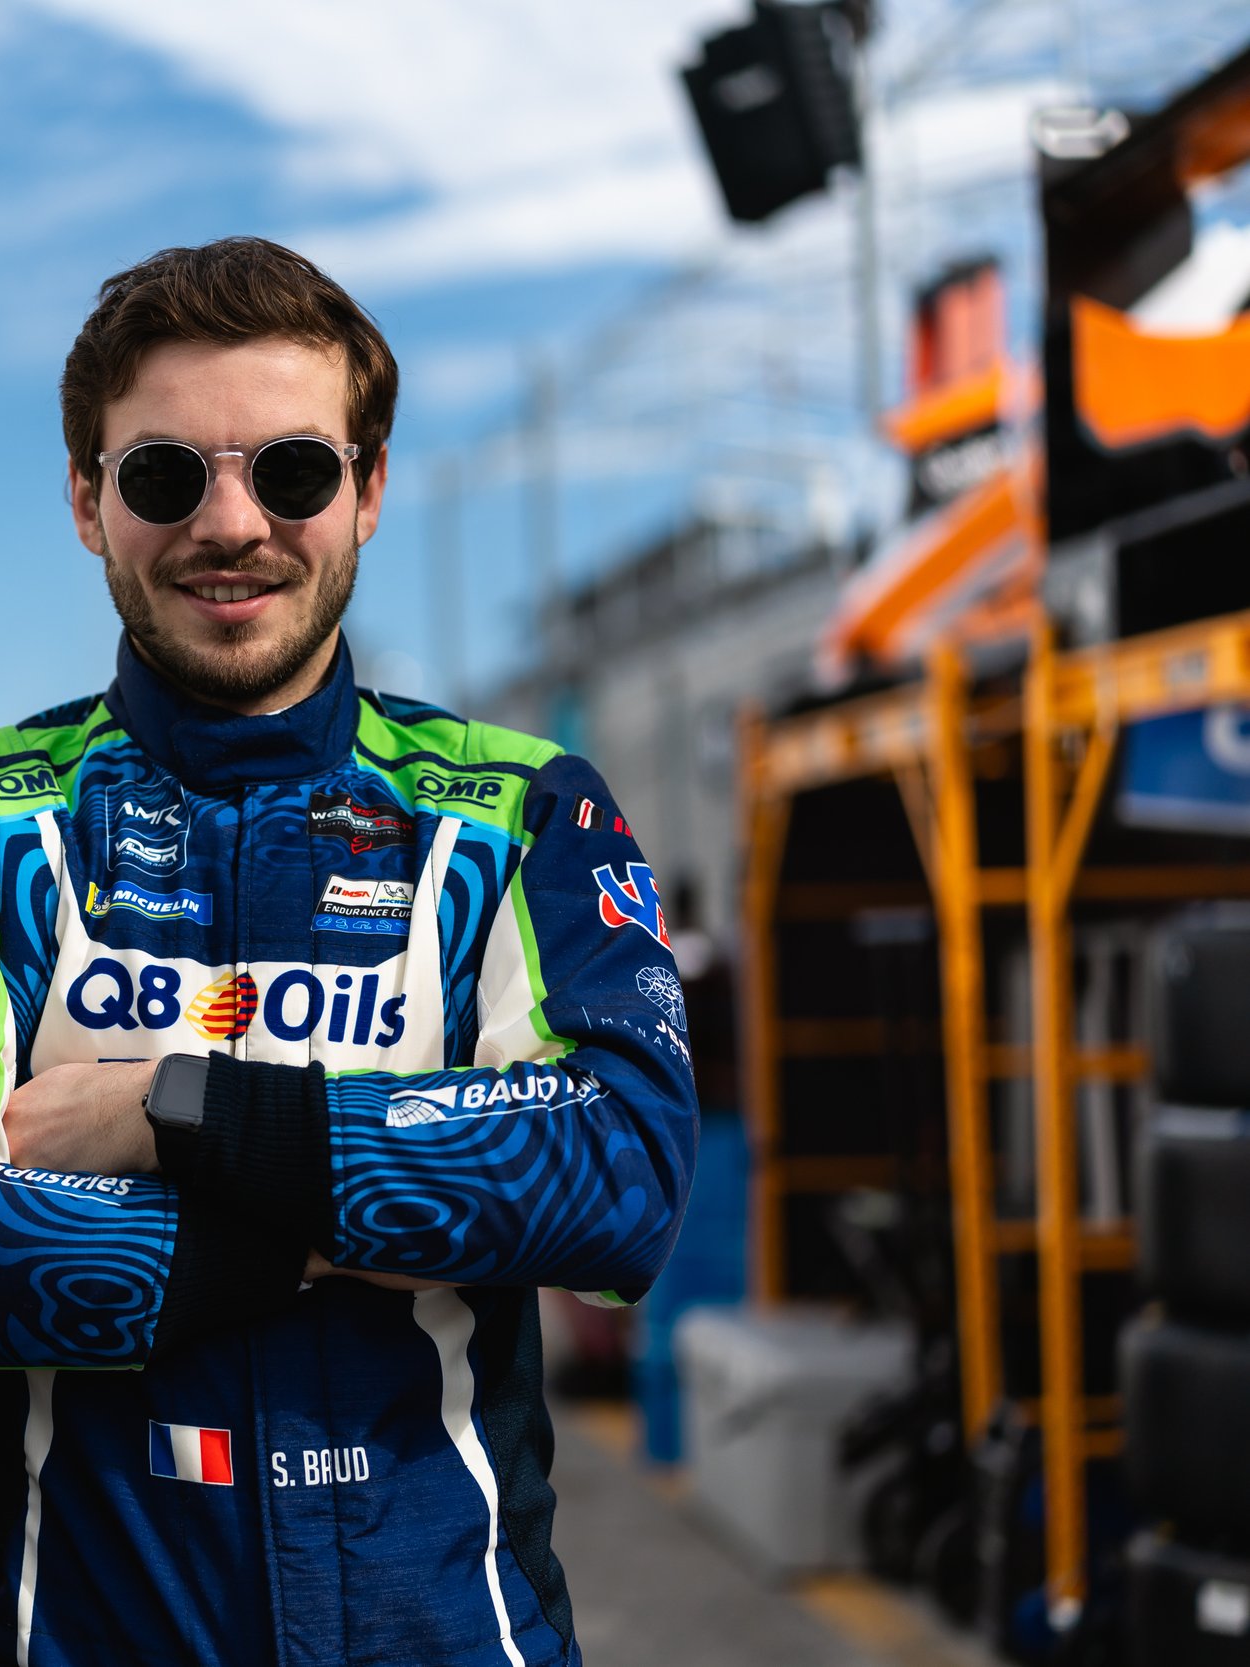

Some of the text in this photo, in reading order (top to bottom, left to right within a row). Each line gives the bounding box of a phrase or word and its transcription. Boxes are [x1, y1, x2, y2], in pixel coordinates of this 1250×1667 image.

[416, 775, 502, 801] OMP
[112, 889, 200, 914] MICHELIN
[341, 889, 370, 898] IMSA
[377, 898, 413, 906] MICHEL
[323, 903, 389, 917] ENDURANCE
[66, 957, 407, 1049] Q8 Oils
[600, 1017, 688, 1066] MANAG
[462, 1075, 559, 1109] BAUD
[271, 1446, 370, 1487] S. BAUD
